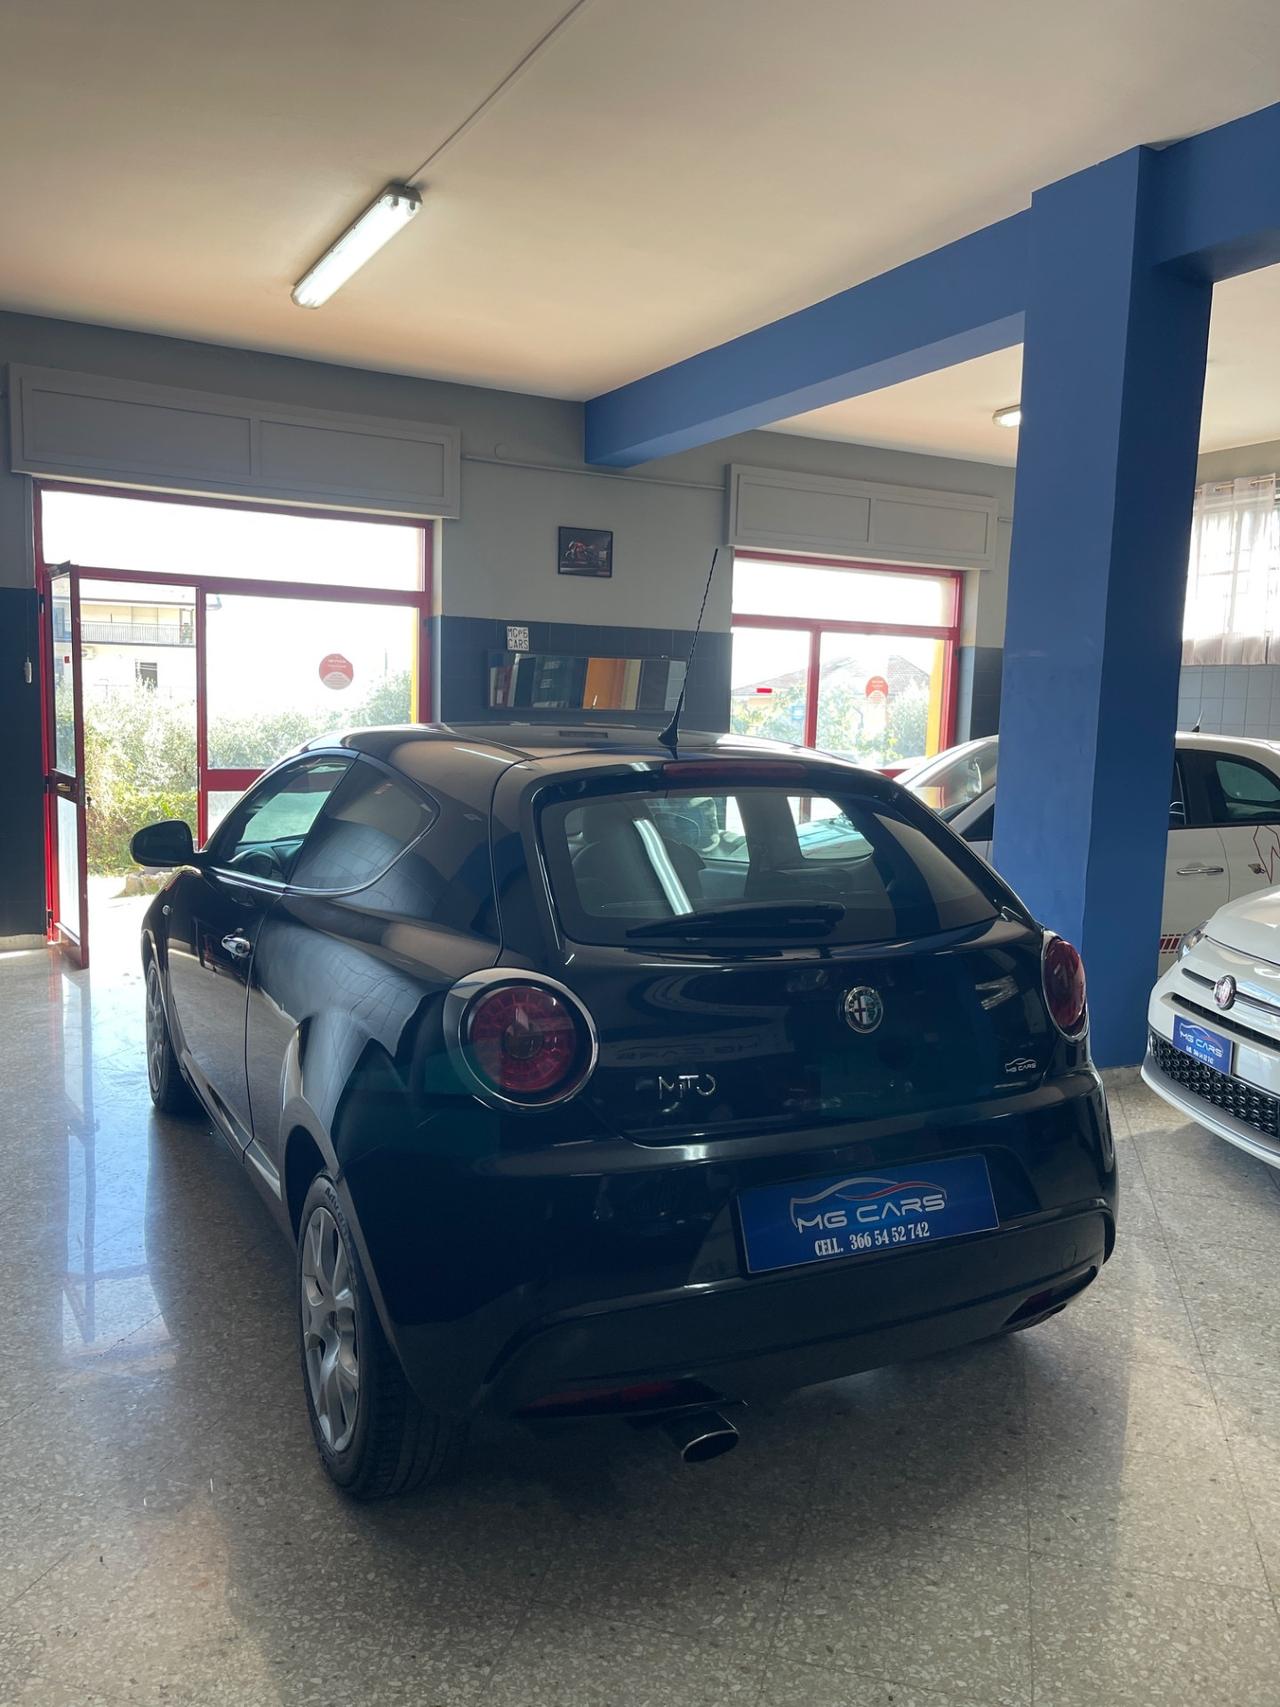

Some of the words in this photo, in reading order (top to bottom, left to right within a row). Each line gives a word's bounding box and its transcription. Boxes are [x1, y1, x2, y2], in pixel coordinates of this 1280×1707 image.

[508, 638, 528, 649] CARS
[1180, 1031, 1194, 1043] MG
[1195, 1038, 1223, 1058] CARS
[797, 1210, 848, 1233] MG
[856, 1194, 946, 1223] CARS
[815, 1238, 844, 1256] CELL.
[849, 1231, 872, 1250] 366
[875, 1228, 889, 1246] 54
[891, 1226, 906, 1242] 52
[908, 1221, 930, 1240] 742
